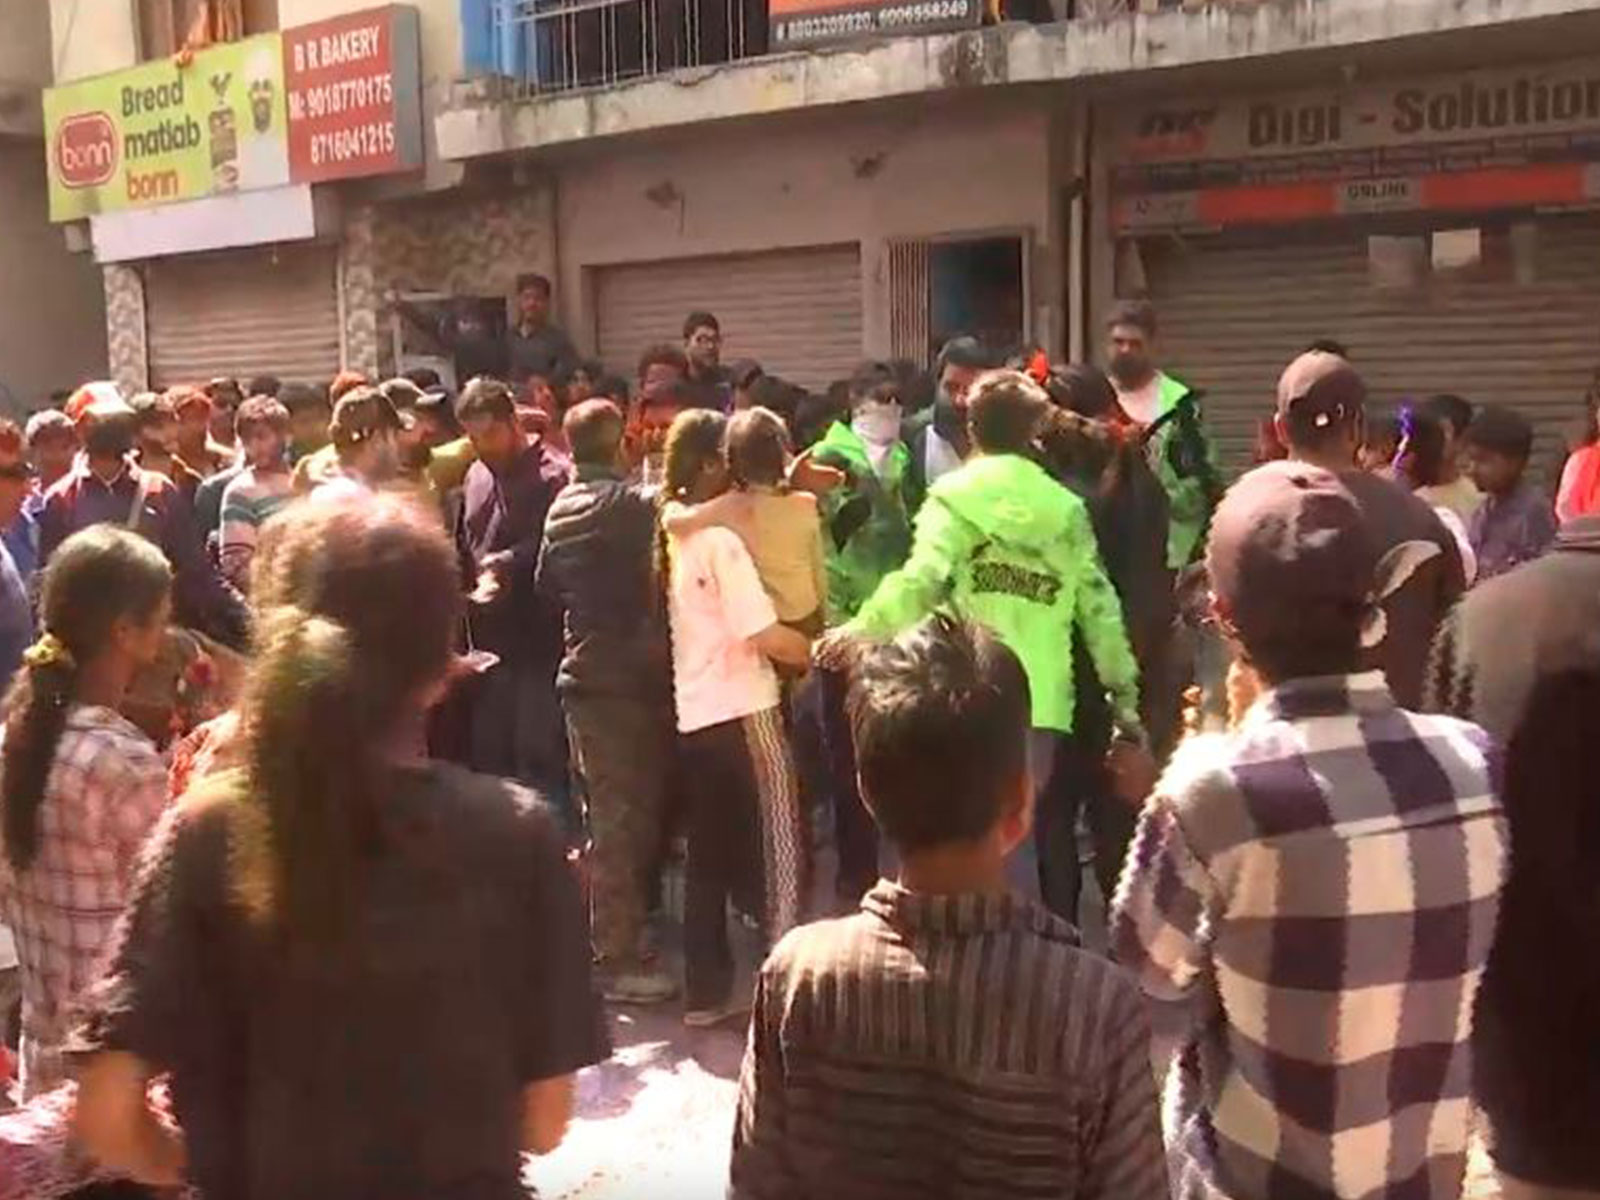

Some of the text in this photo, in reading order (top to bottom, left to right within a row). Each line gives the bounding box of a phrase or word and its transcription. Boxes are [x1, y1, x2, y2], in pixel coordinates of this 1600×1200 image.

[294, 25, 380, 72] B R BAKERY
[121, 73, 184, 117] Bread
[307, 74, 393, 118] 9018770175
[125, 115, 201, 159] matlab
[1249, 95, 1341, 146] Digi
[61, 135, 111, 170] bonn
[311, 122, 395, 166] 8716041215
[126, 168, 178, 201] bonn
